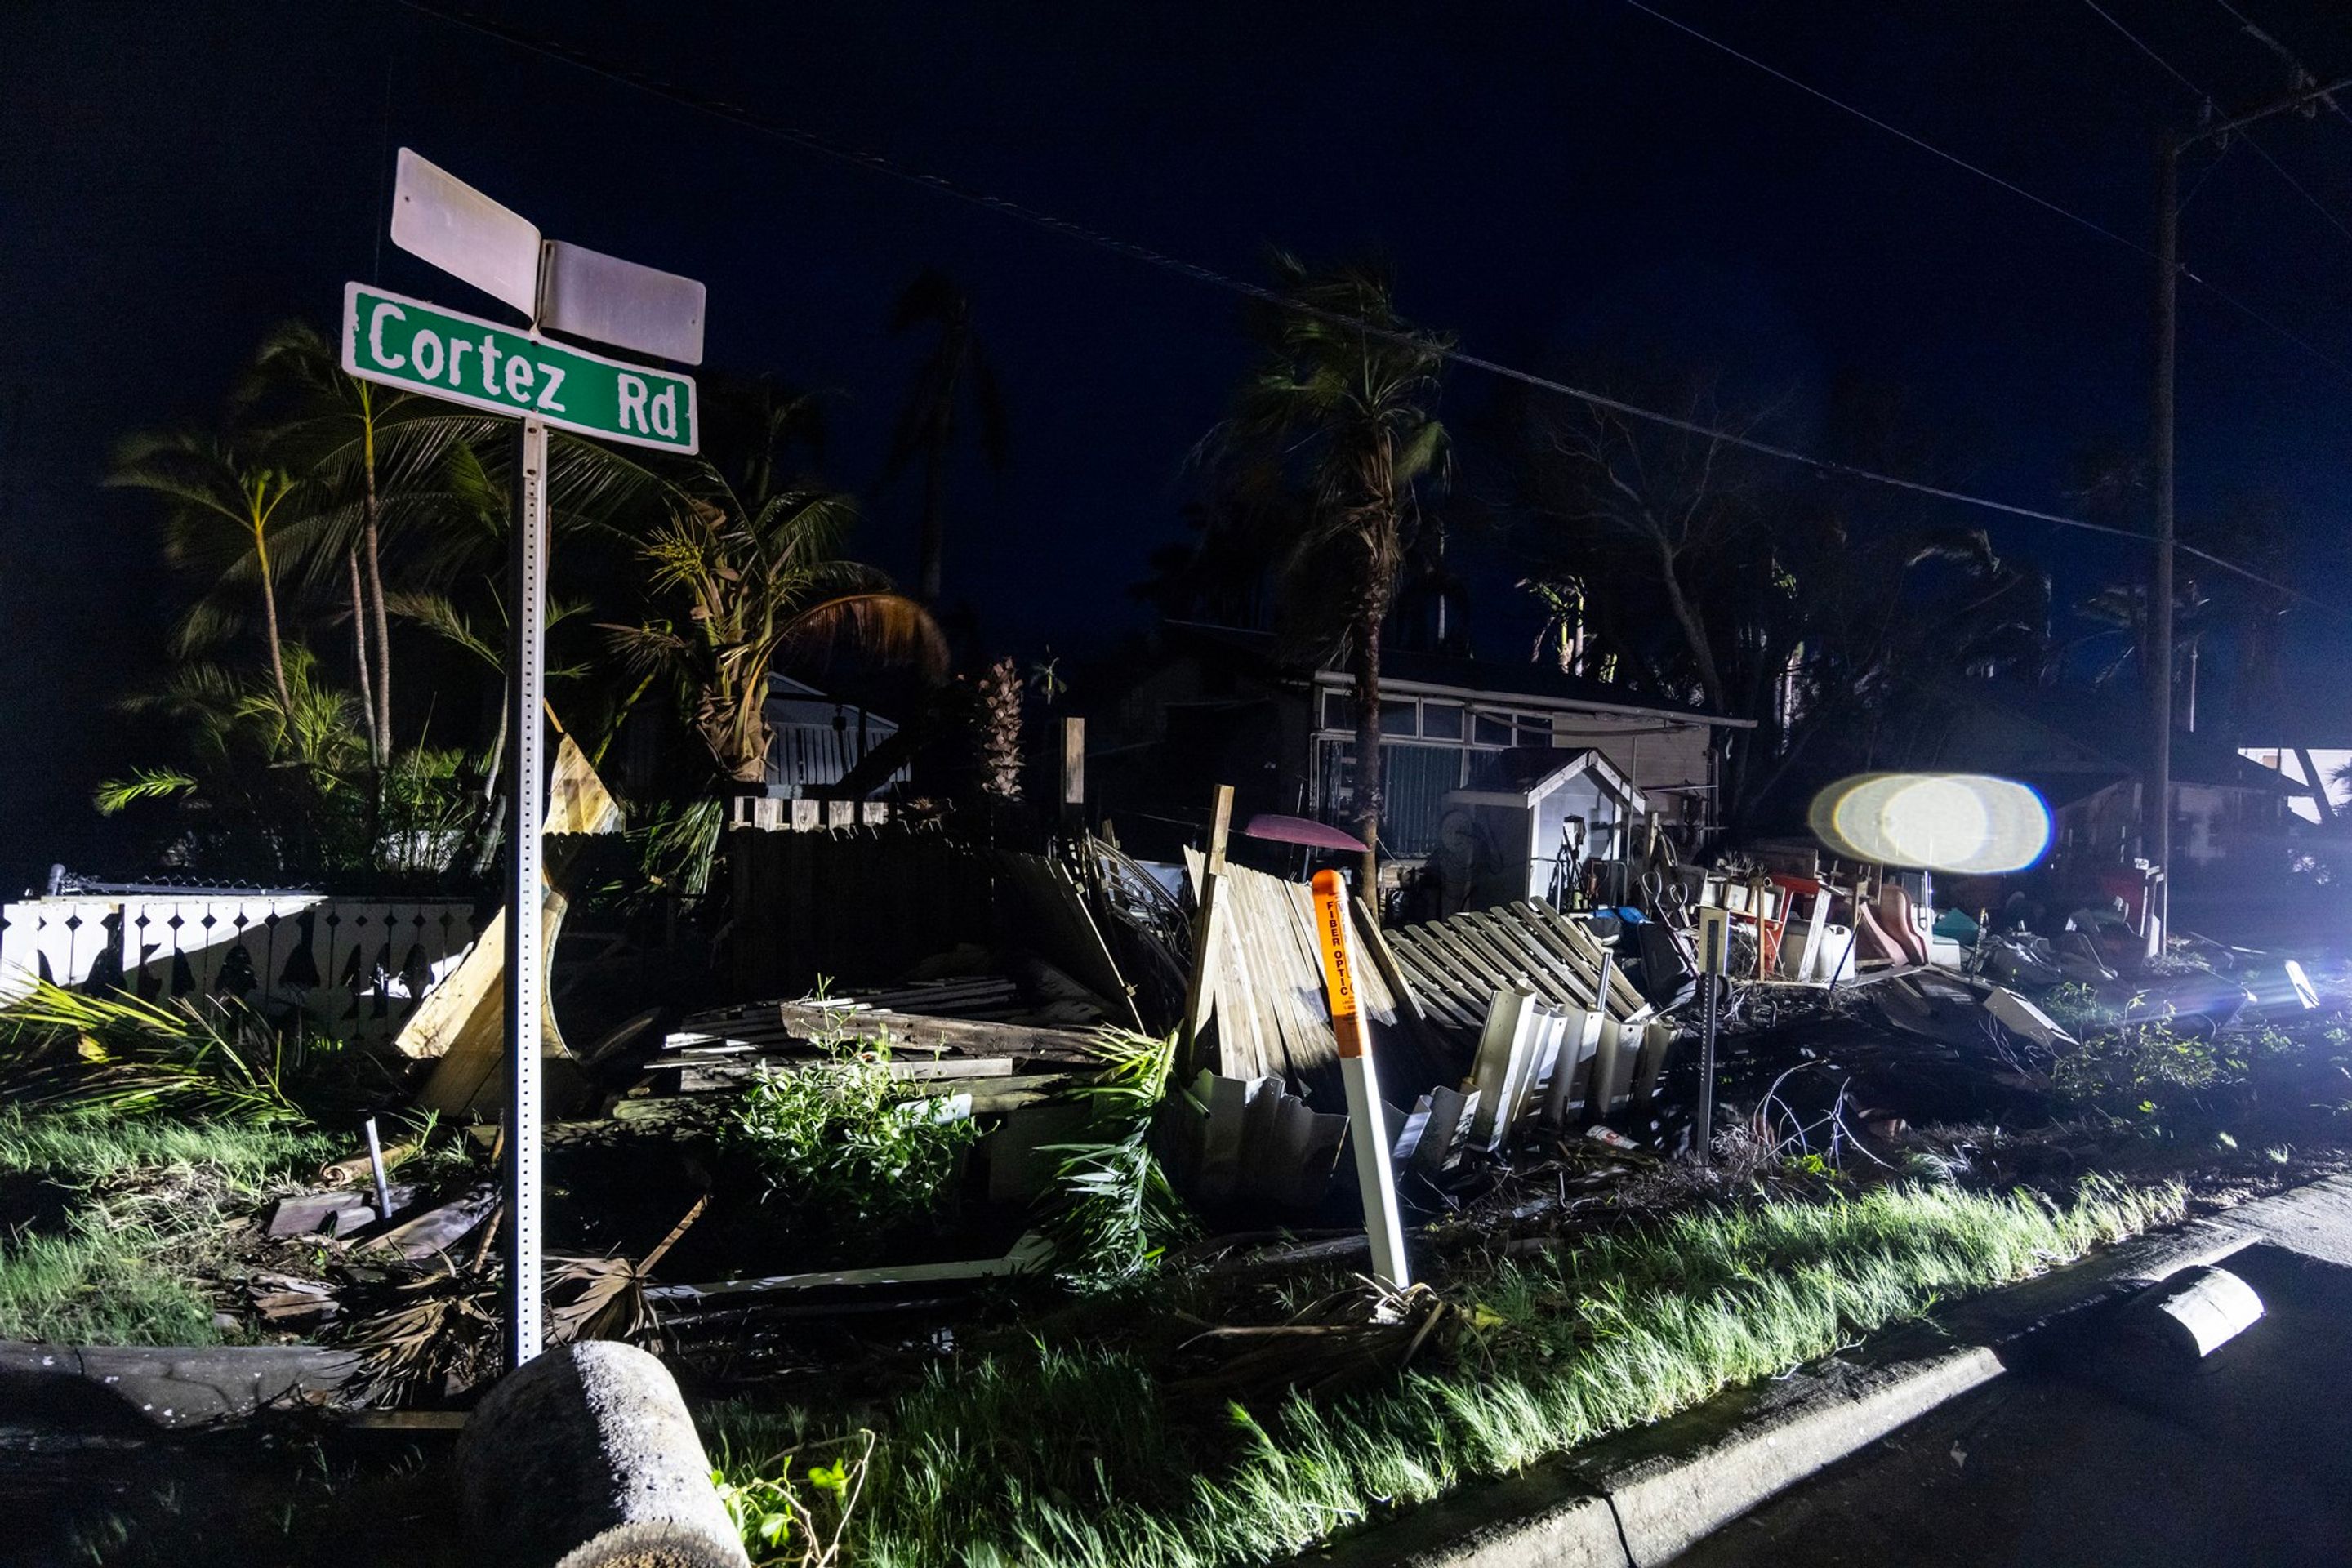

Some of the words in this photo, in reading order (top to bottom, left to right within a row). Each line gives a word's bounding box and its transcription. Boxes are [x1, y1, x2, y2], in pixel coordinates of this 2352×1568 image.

[369, 302, 566, 412] Cortez
[617, 372, 679, 439] Rd
[1326, 901, 1341, 947] FIBER
[1334, 950, 1348, 996] OPTIC
